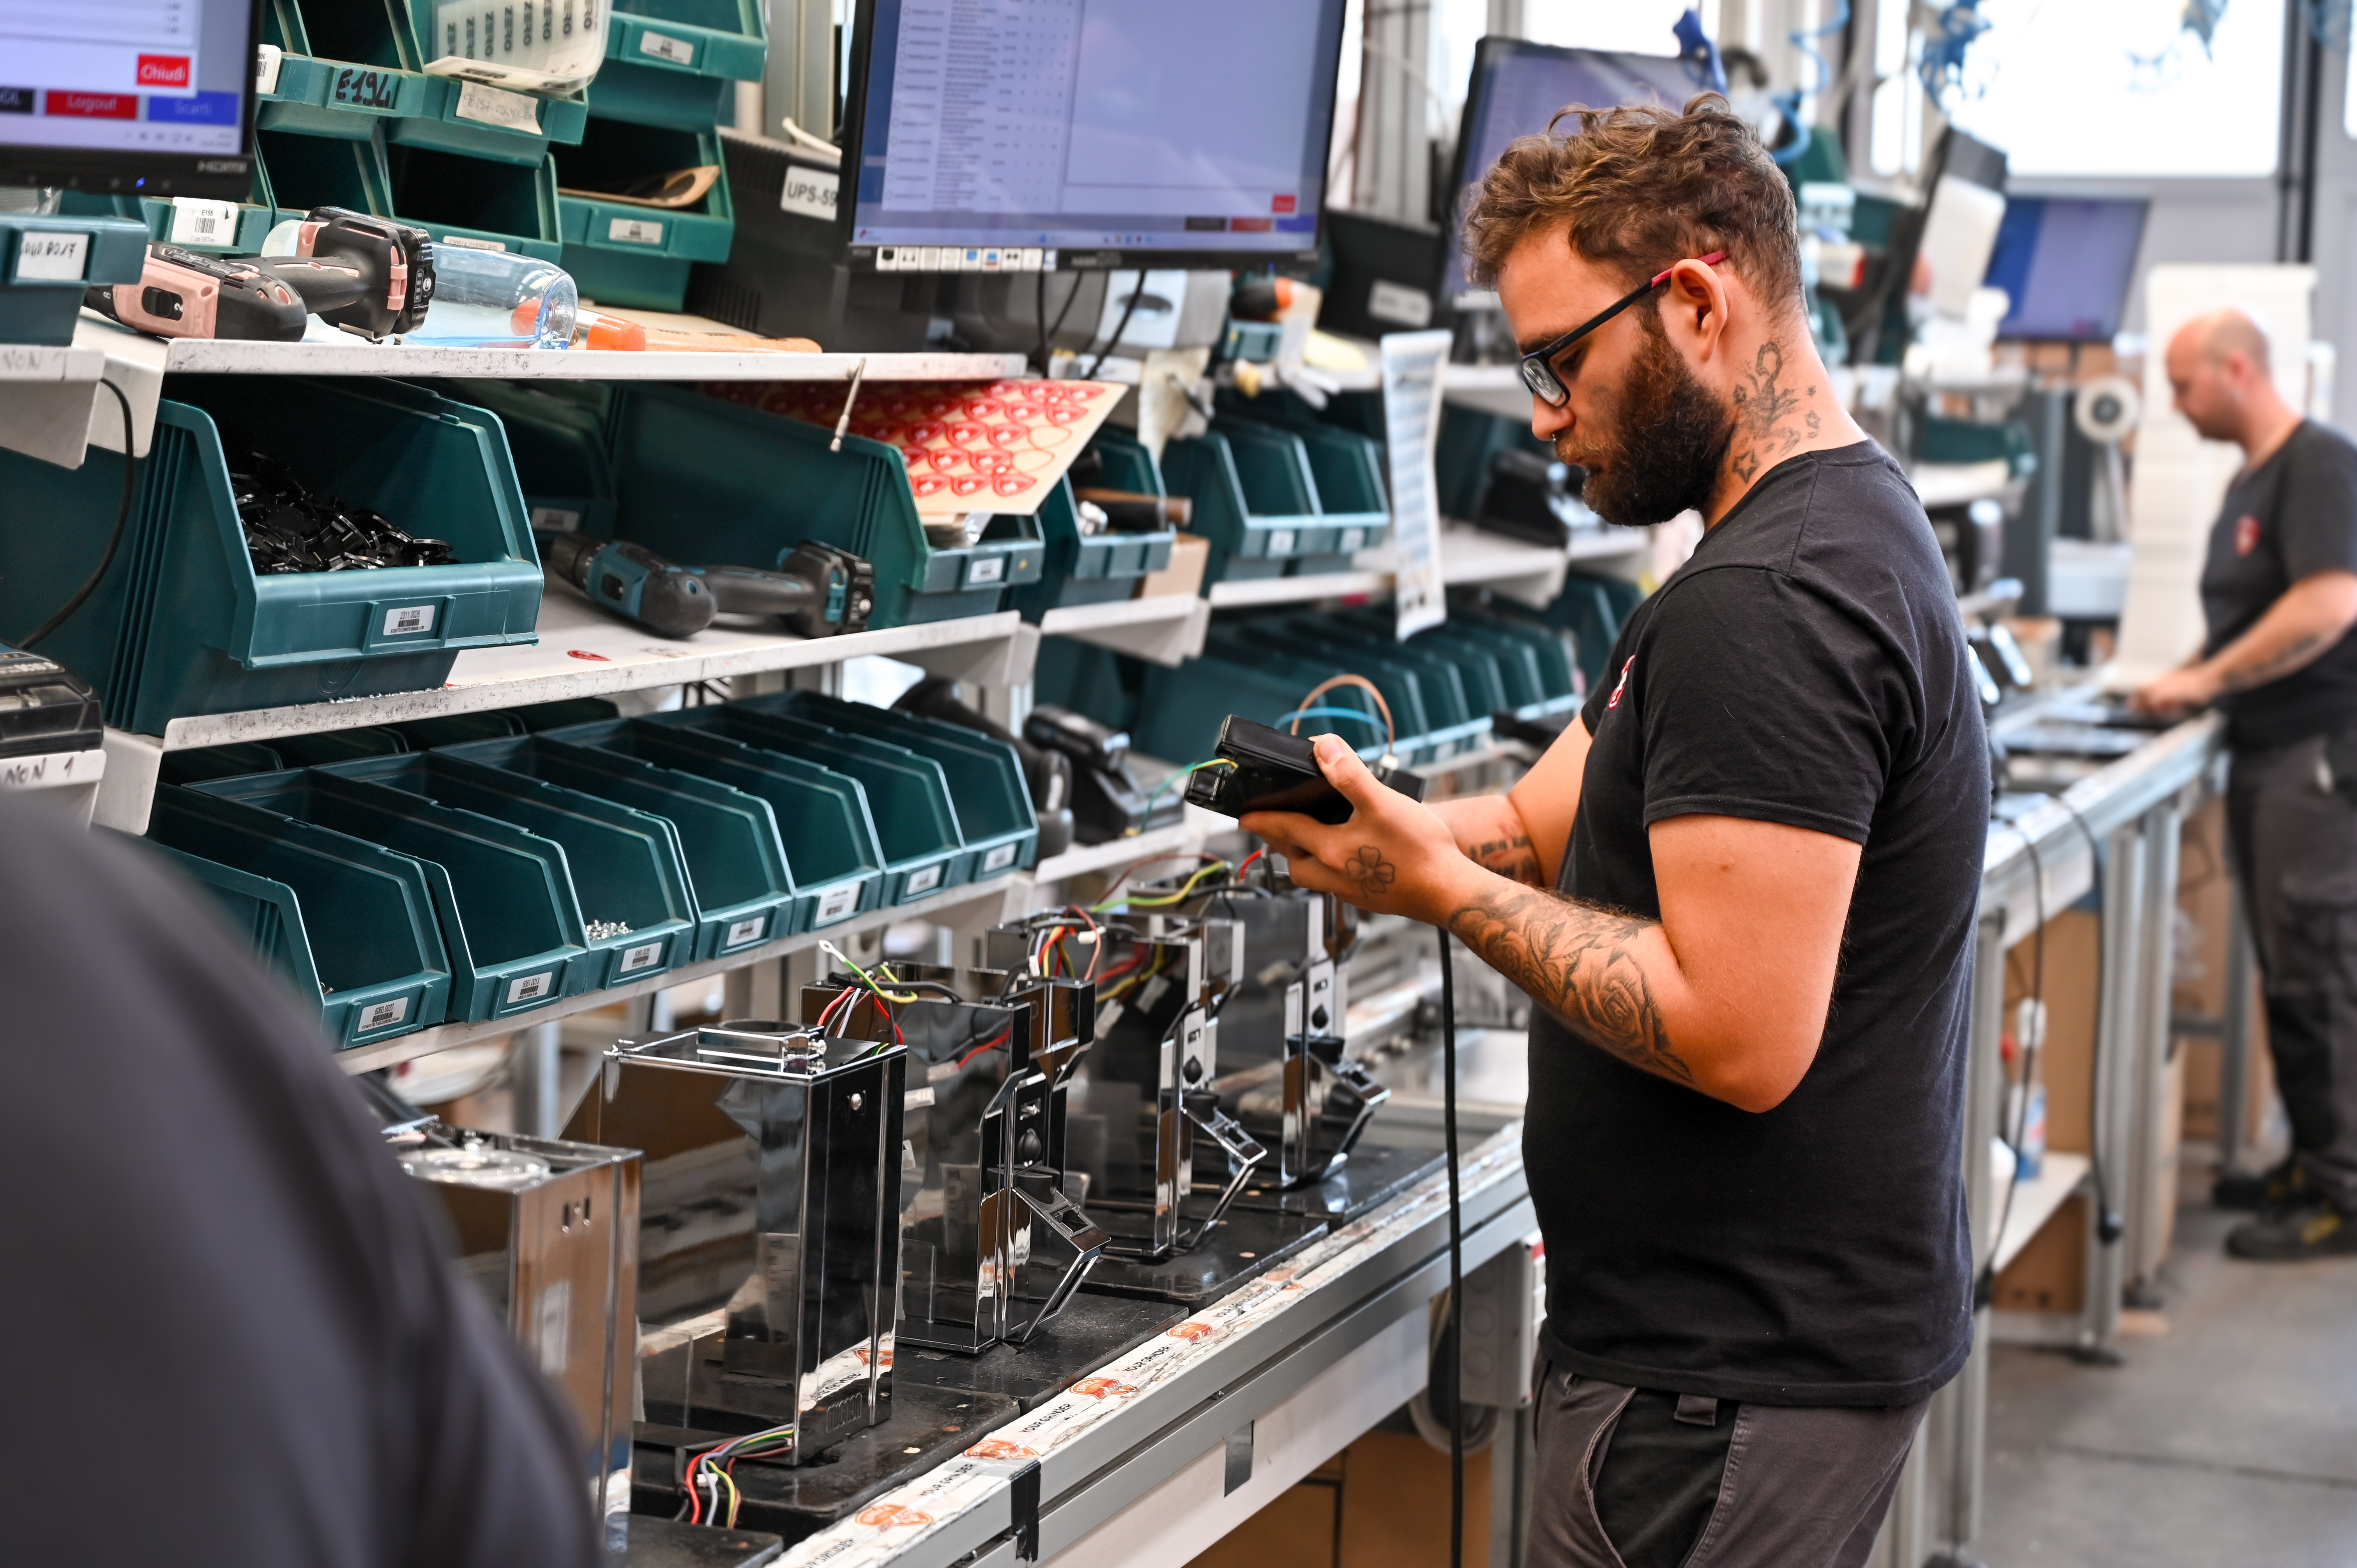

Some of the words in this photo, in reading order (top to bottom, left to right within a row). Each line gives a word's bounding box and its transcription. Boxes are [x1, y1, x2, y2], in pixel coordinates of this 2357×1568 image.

[504, 5, 513, 51] ZERO
[523, 1, 532, 46] ZERO
[543, 0, 551, 40] ERO
[563, 0, 572, 34] ERO
[584, 0, 592, 29] ERO
[485, 11, 493, 56] ZERO
[140, 63, 186, 81] Chiudi
[67, 93, 117, 113] Logout
[103, 291, 111, 300] 8
[174, 303, 184, 313] 2
[1172, 1323, 1196, 1335] EUREKA
[1122, 1361, 1147, 1372] YOUR
[1141, 1346, 1173, 1362] GRINDER
[1076, 1379, 1103, 1392] EUREKA
[1019, 1421, 1043, 1432] YOUR
[1039, 1403, 1075, 1424] GRINDER
